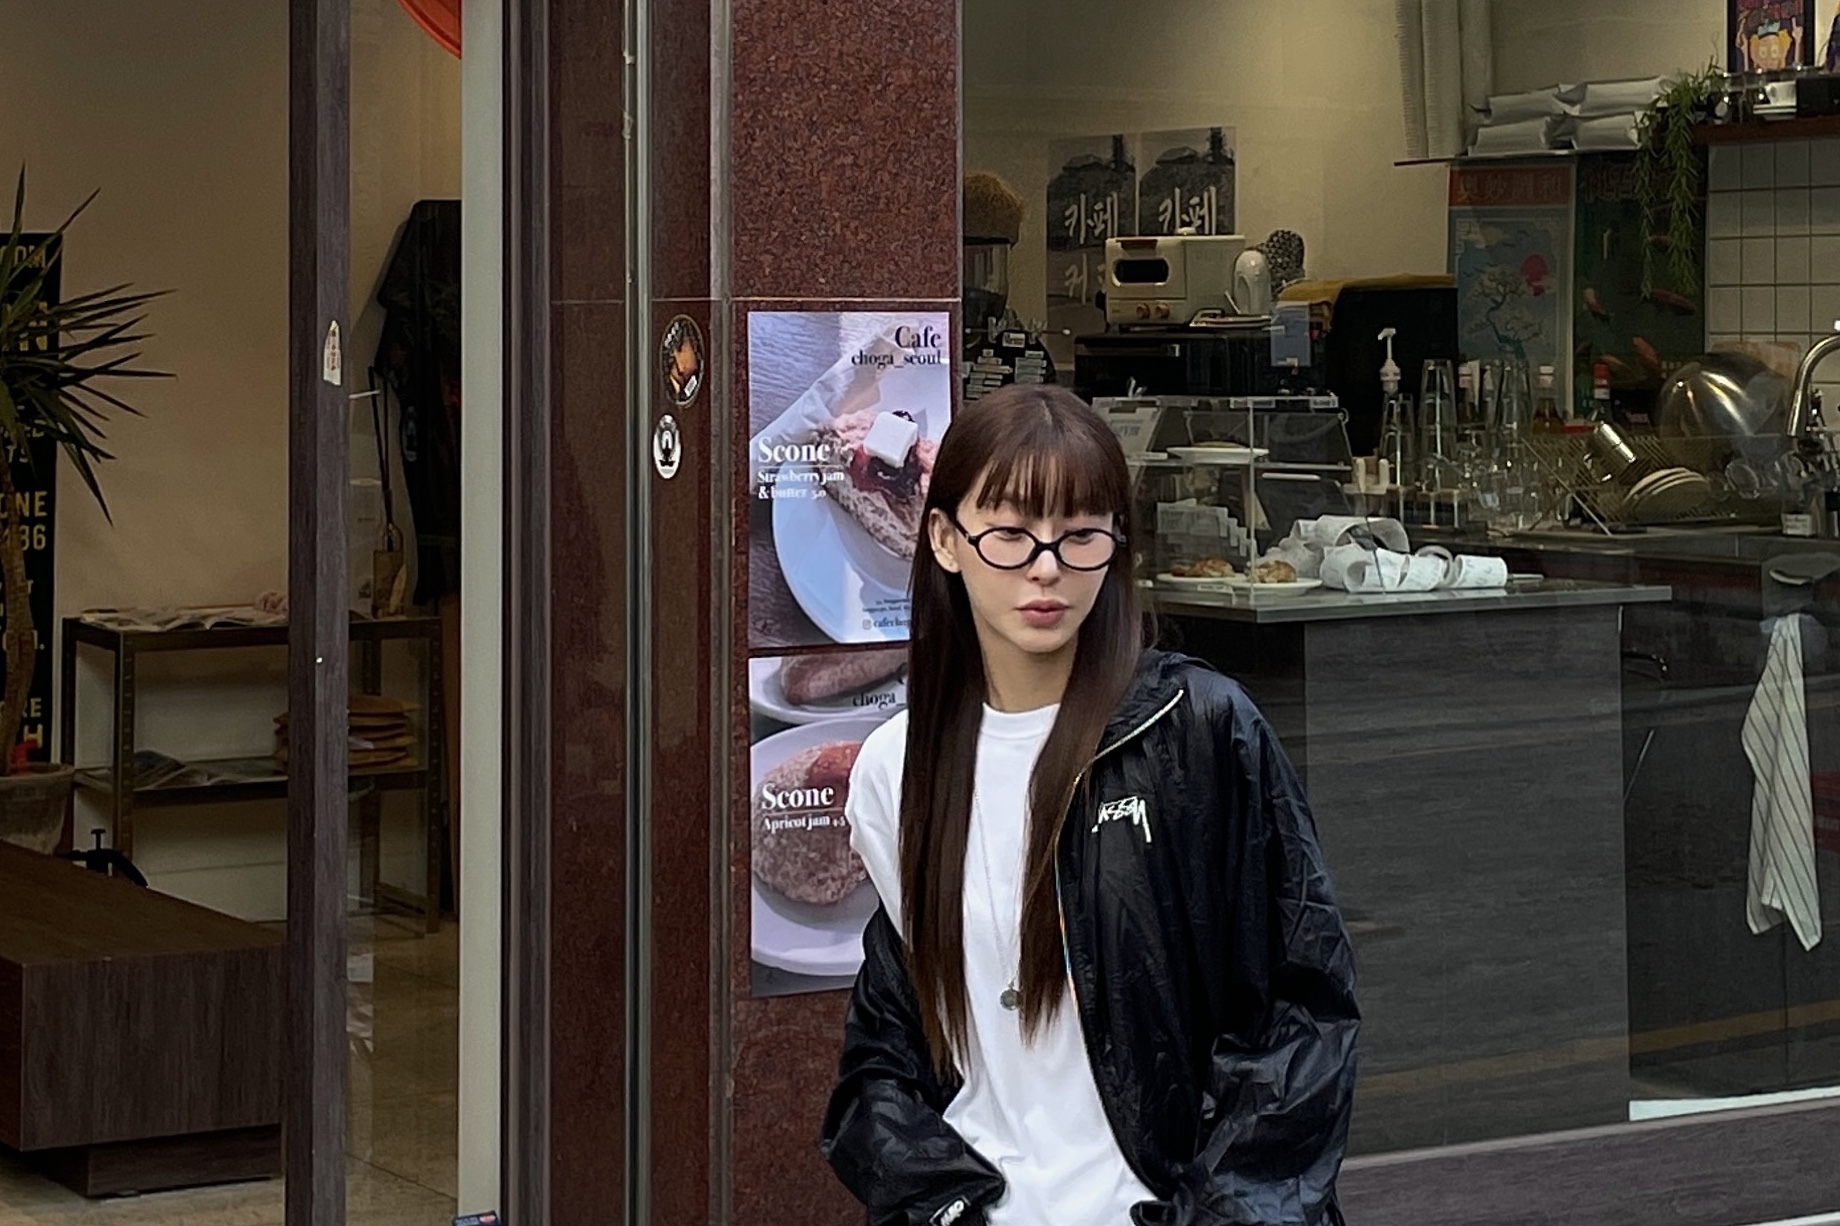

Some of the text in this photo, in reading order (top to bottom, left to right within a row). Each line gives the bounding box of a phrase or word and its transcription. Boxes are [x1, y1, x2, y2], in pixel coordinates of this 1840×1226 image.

[894, 325, 941, 349] Cafe
[851, 349, 942, 370] choga_seoul
[758, 436, 831, 463] Scone
[757, 470, 844, 485] Strawberry jam
[758, 485, 769, 499] &
[852, 690, 907, 711] choga_
[761, 782, 834, 810] Scone
[764, 814, 806, 835] Apricot
[806, 812, 831, 831] jam
